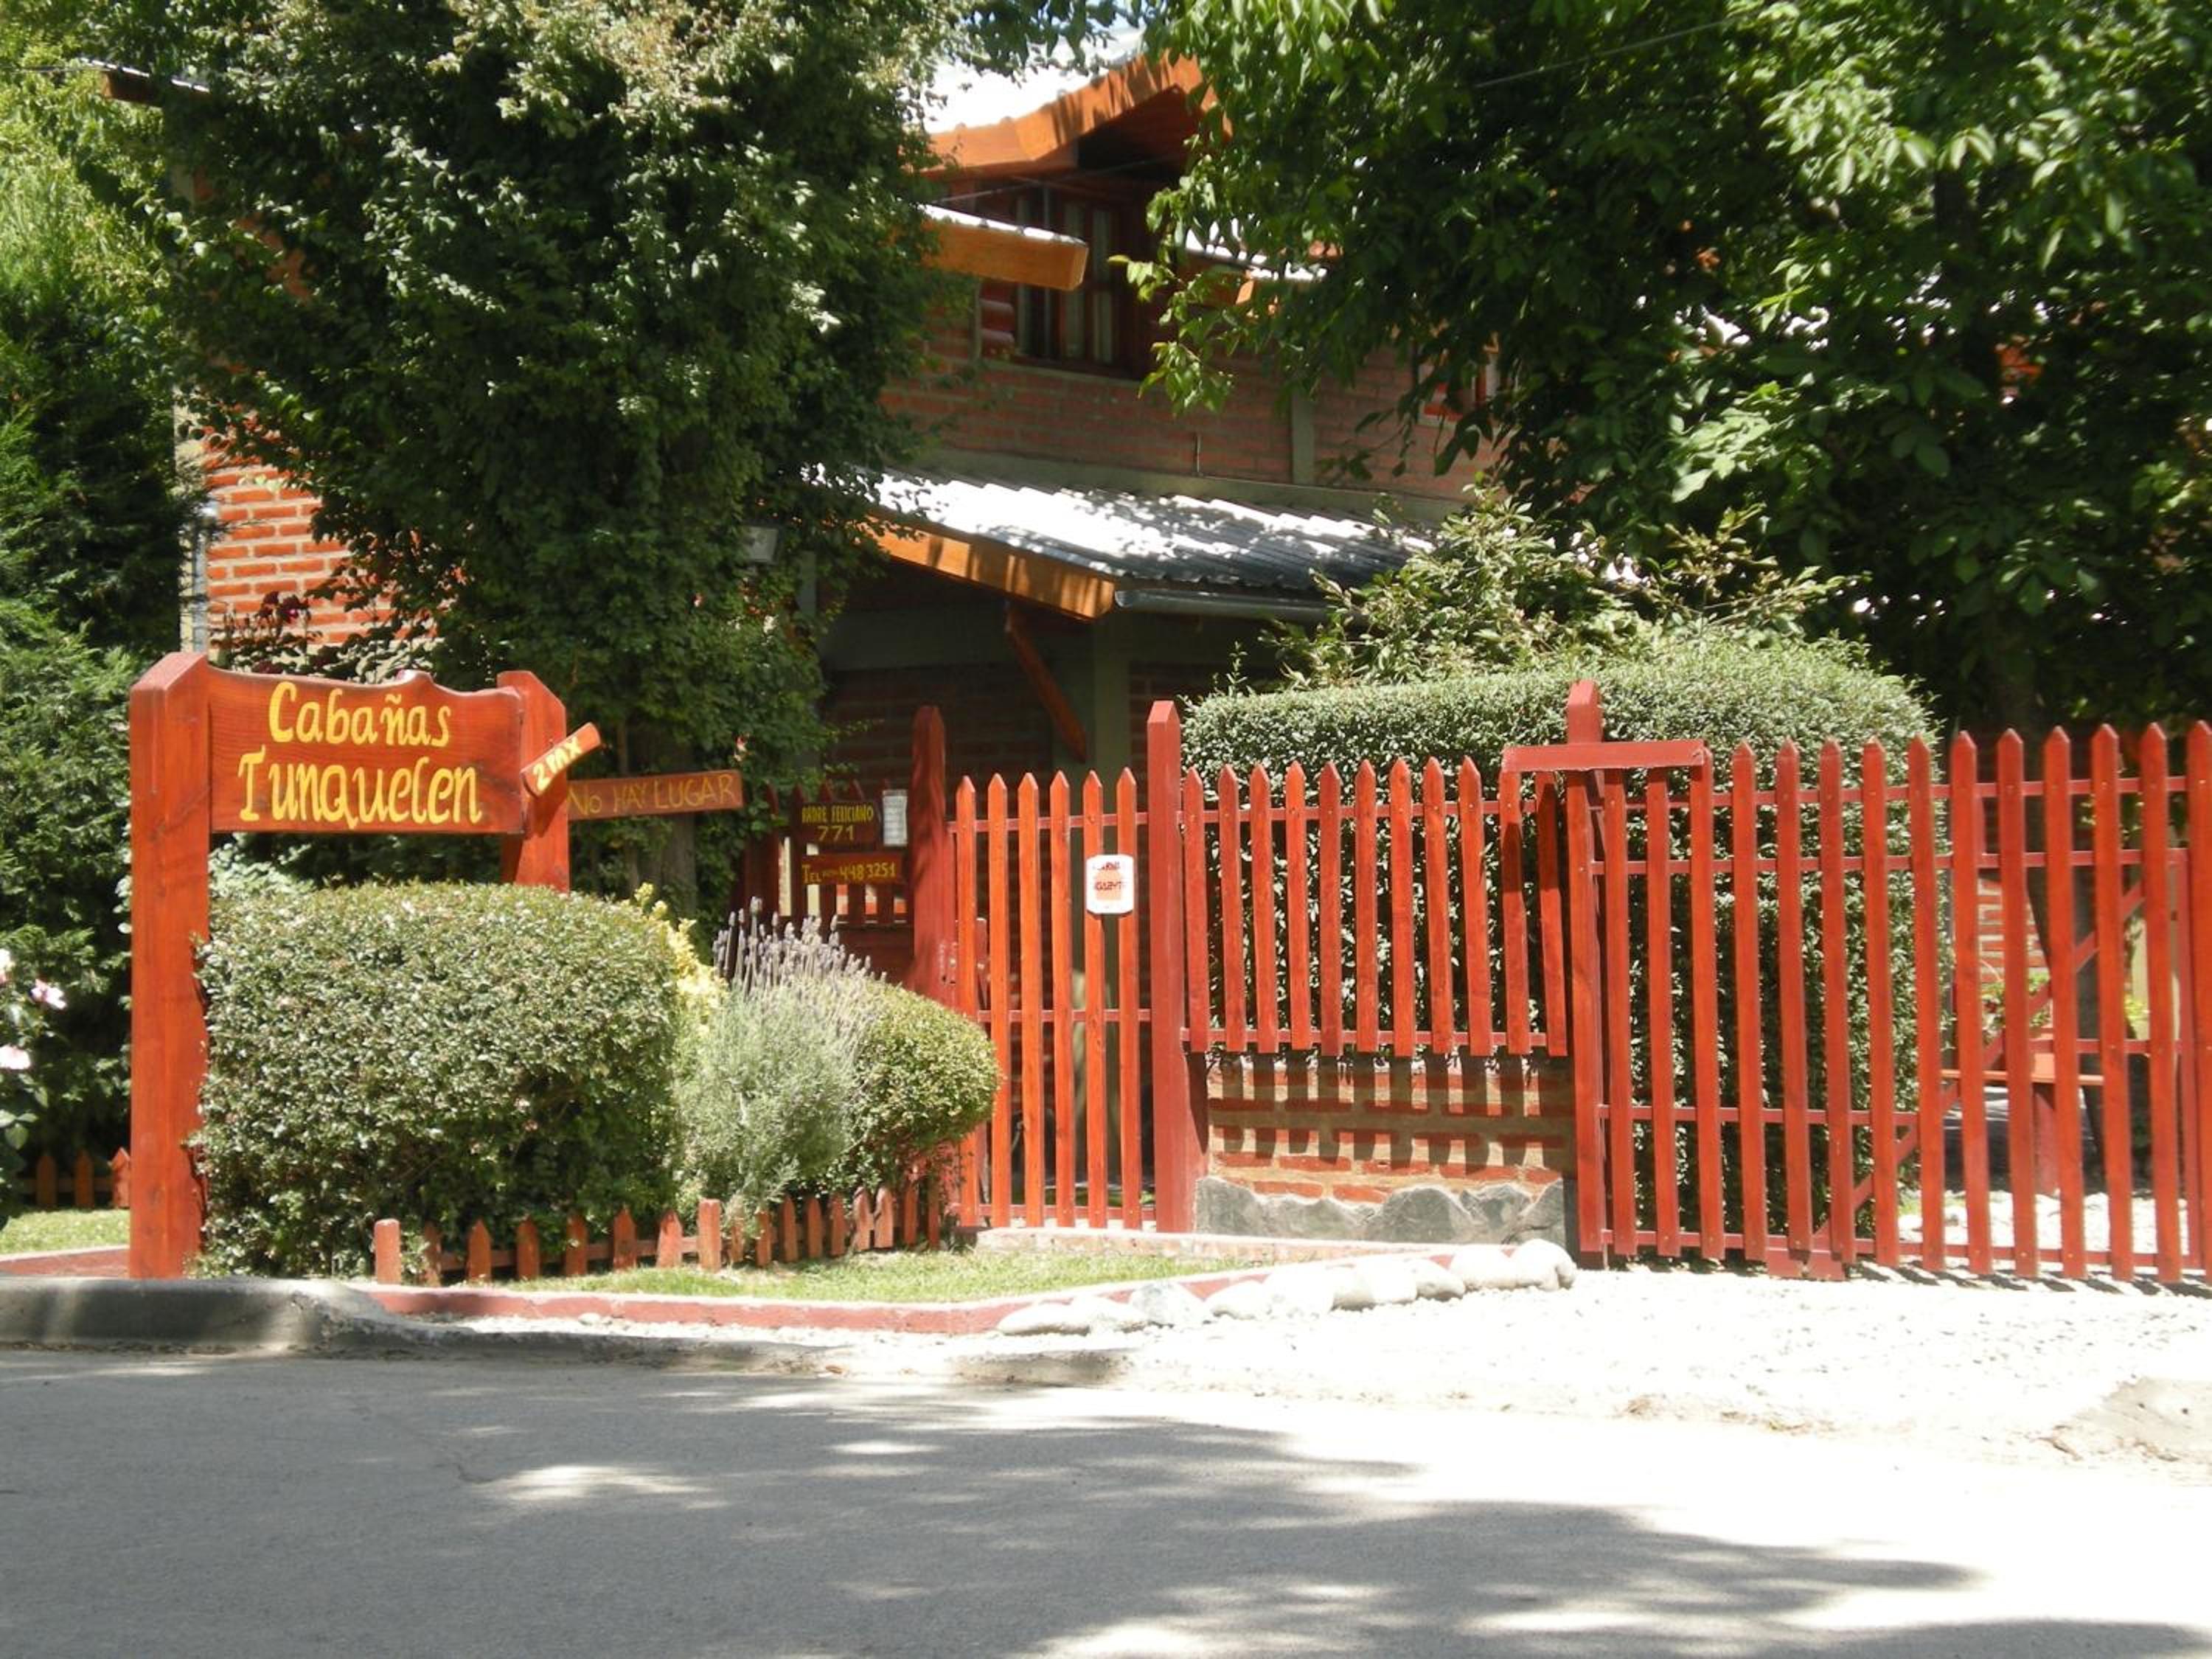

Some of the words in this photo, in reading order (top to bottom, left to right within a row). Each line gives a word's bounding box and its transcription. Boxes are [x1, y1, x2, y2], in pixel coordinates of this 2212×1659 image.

[268, 681, 451, 748] Cabañas
[238, 744, 482, 829] Tunquelen
[613, 782, 647, 815] HAY
[654, 773, 734, 810] LUGAR
[817, 825, 855, 842] 771
